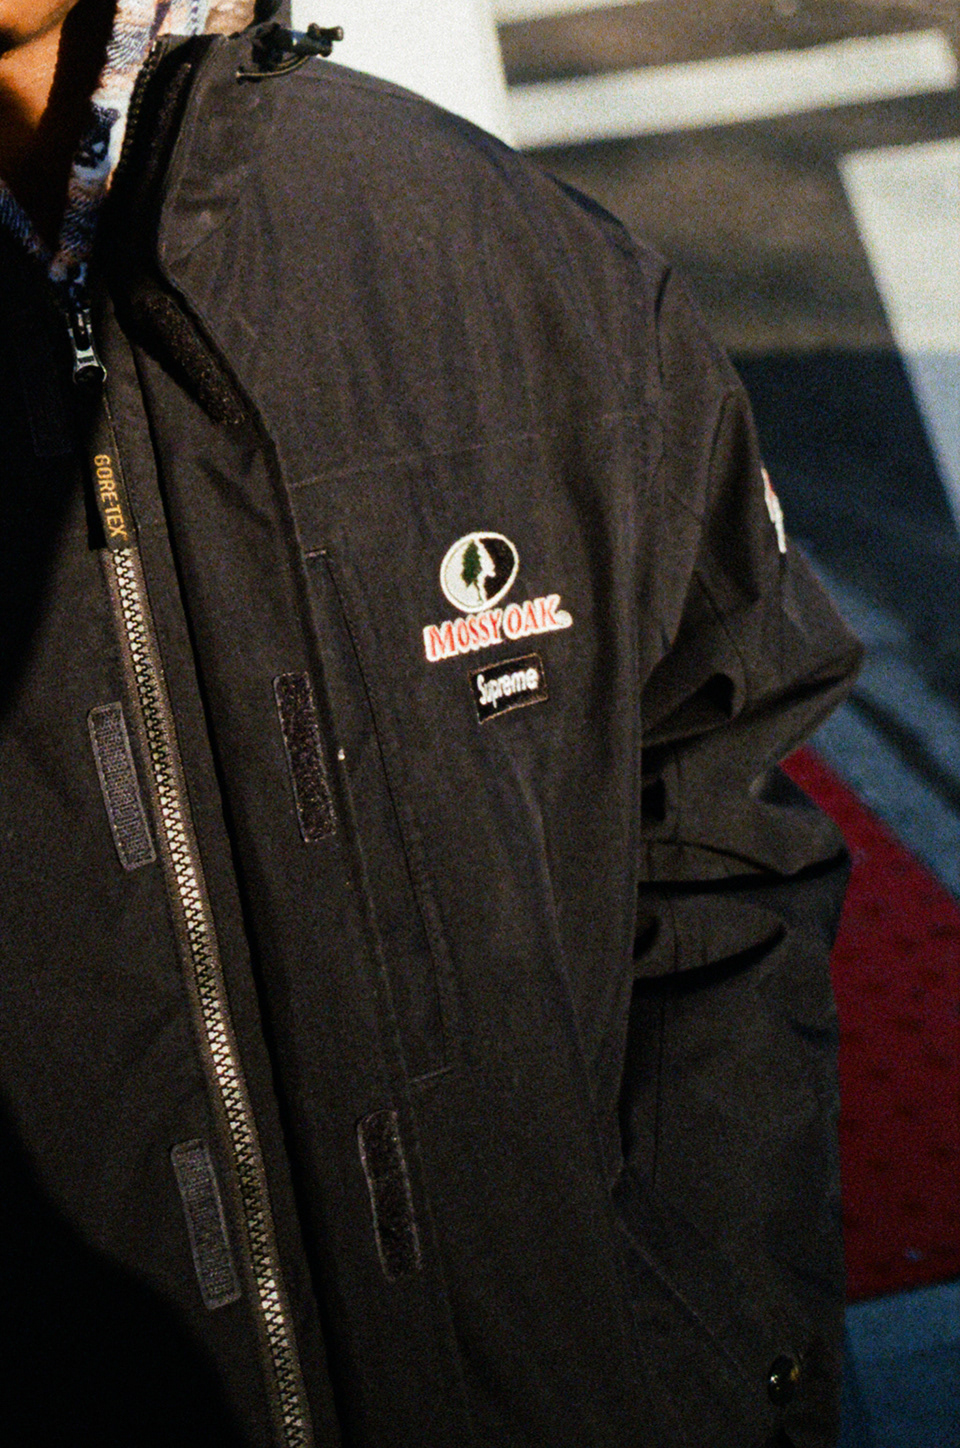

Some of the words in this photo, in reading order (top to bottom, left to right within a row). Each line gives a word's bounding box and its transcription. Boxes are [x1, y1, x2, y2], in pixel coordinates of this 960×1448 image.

[94, 454, 128, 541] GORE-TEX
[425, 608, 504, 662] MOSSY
[503, 595, 571, 640] OAK
[477, 668, 539, 709] Supreme
